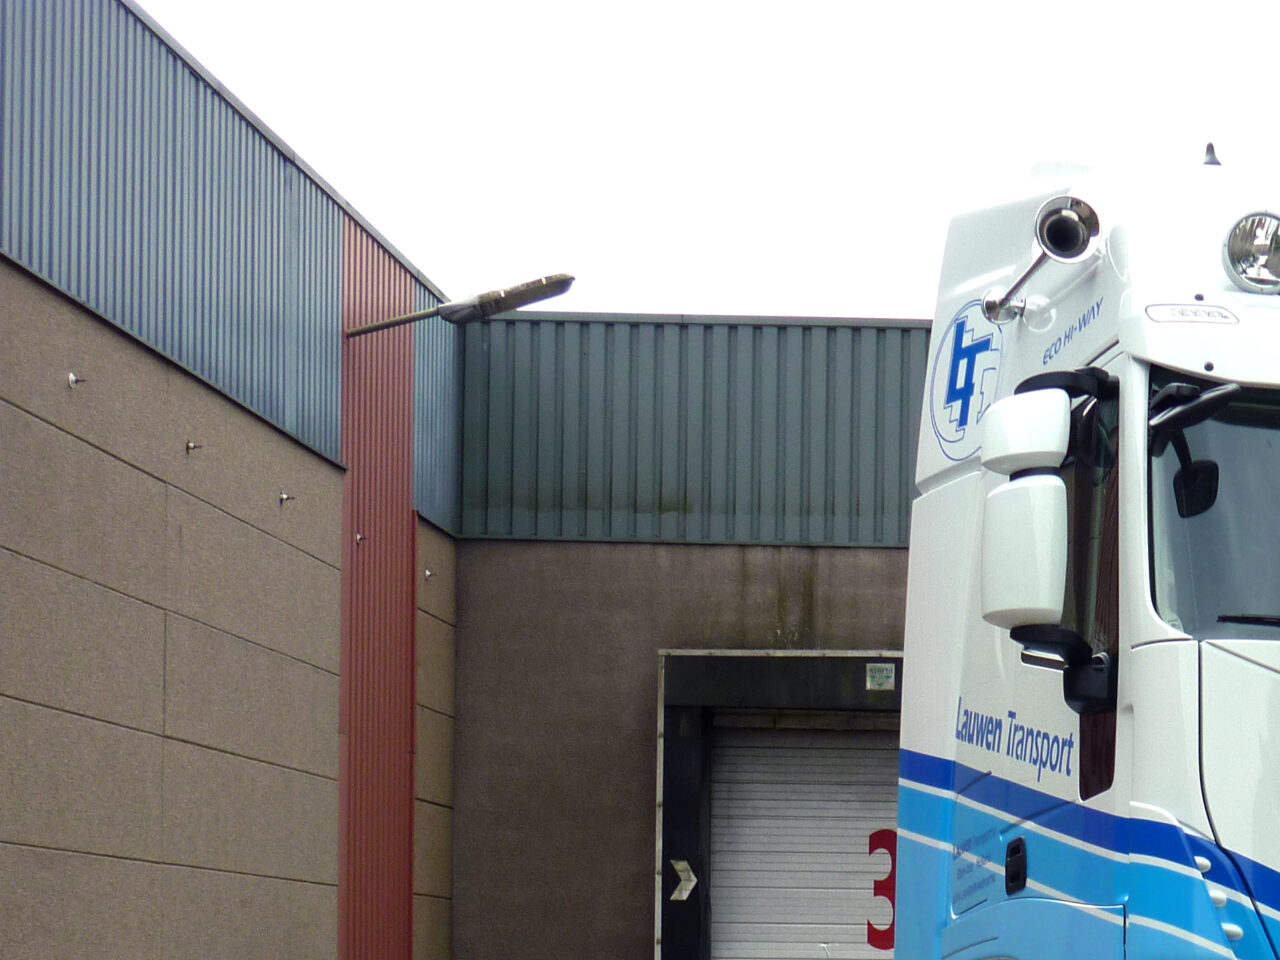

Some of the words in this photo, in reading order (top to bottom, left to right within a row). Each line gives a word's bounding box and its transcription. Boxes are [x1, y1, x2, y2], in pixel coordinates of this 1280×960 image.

[1042, 336, 1062, 366] ECO
[1063, 296, 1103, 347] HI-WAY
[955, 697, 1002, 753] Lauwen
[1006, 711, 1074, 782] Transport
[867, 828, 896, 949] 3
